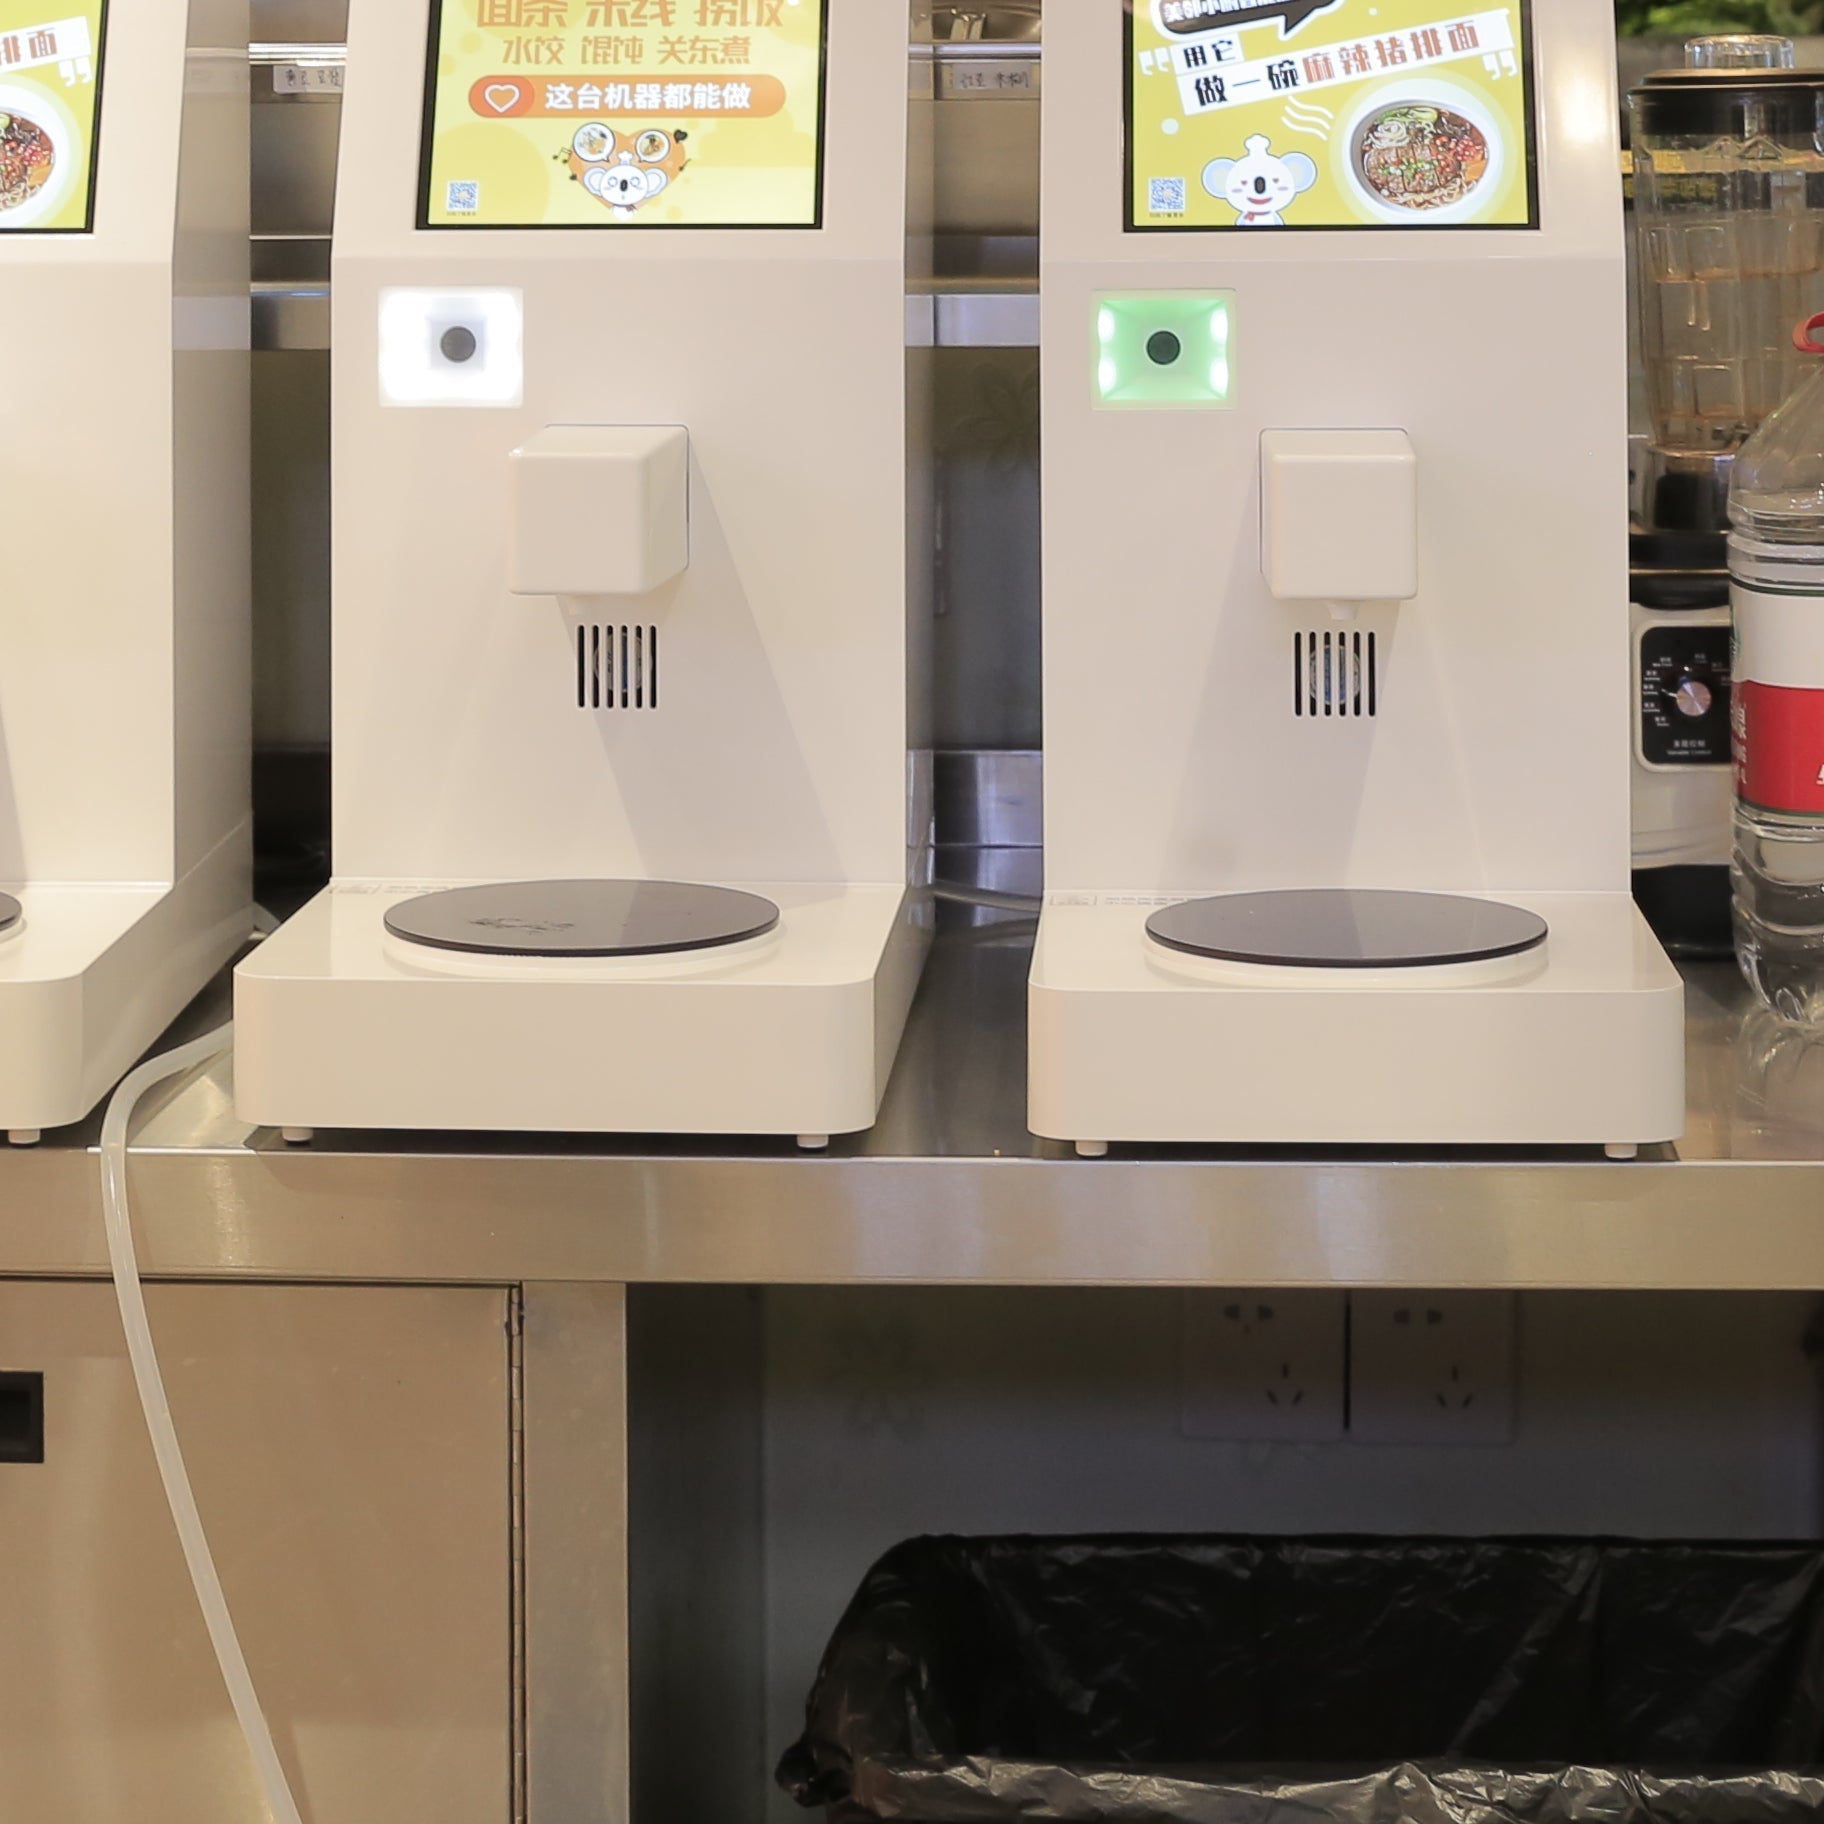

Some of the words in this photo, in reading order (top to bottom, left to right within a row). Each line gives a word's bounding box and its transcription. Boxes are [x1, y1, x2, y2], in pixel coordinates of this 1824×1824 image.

[502, 36, 565, 65] 水饺
[580, 35, 644, 64] 馄饨
[657, 35, 751, 64] 关东煮
[1183, 39, 1234, 68] 用它
[545, 83, 752, 110] 这台机器都能做
